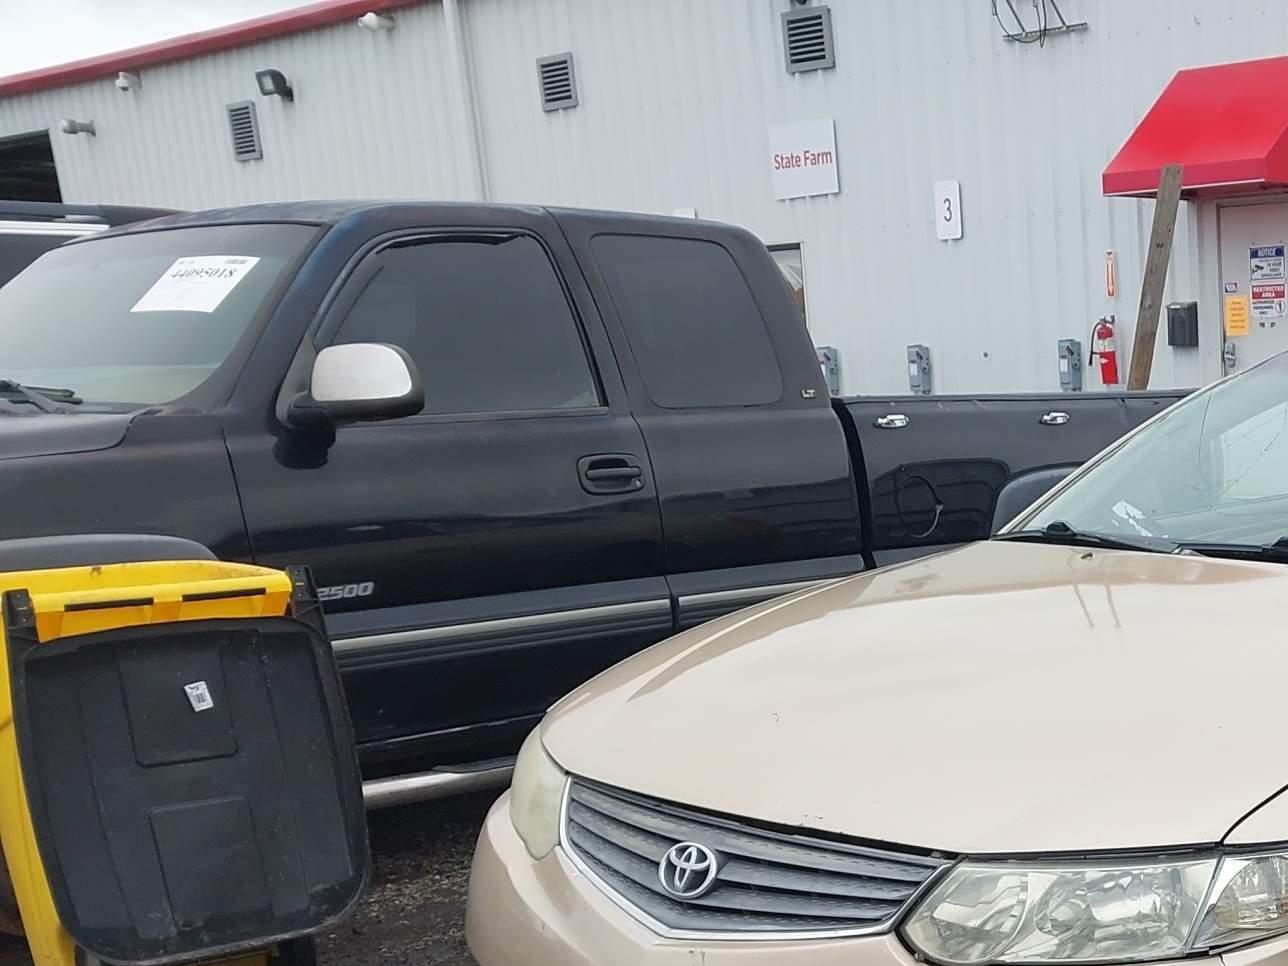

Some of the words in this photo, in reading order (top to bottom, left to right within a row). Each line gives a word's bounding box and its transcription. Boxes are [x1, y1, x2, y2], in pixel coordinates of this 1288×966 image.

[774, 153, 801, 170] State
[803, 149, 833, 167] Farm
[943, 198, 952, 222] 3
[1257, 248, 1276, 257] NOTICE
[171, 267, 237, 278] 44095018
[801, 389, 815, 398] LT
[316, 581, 375, 601] 2500
